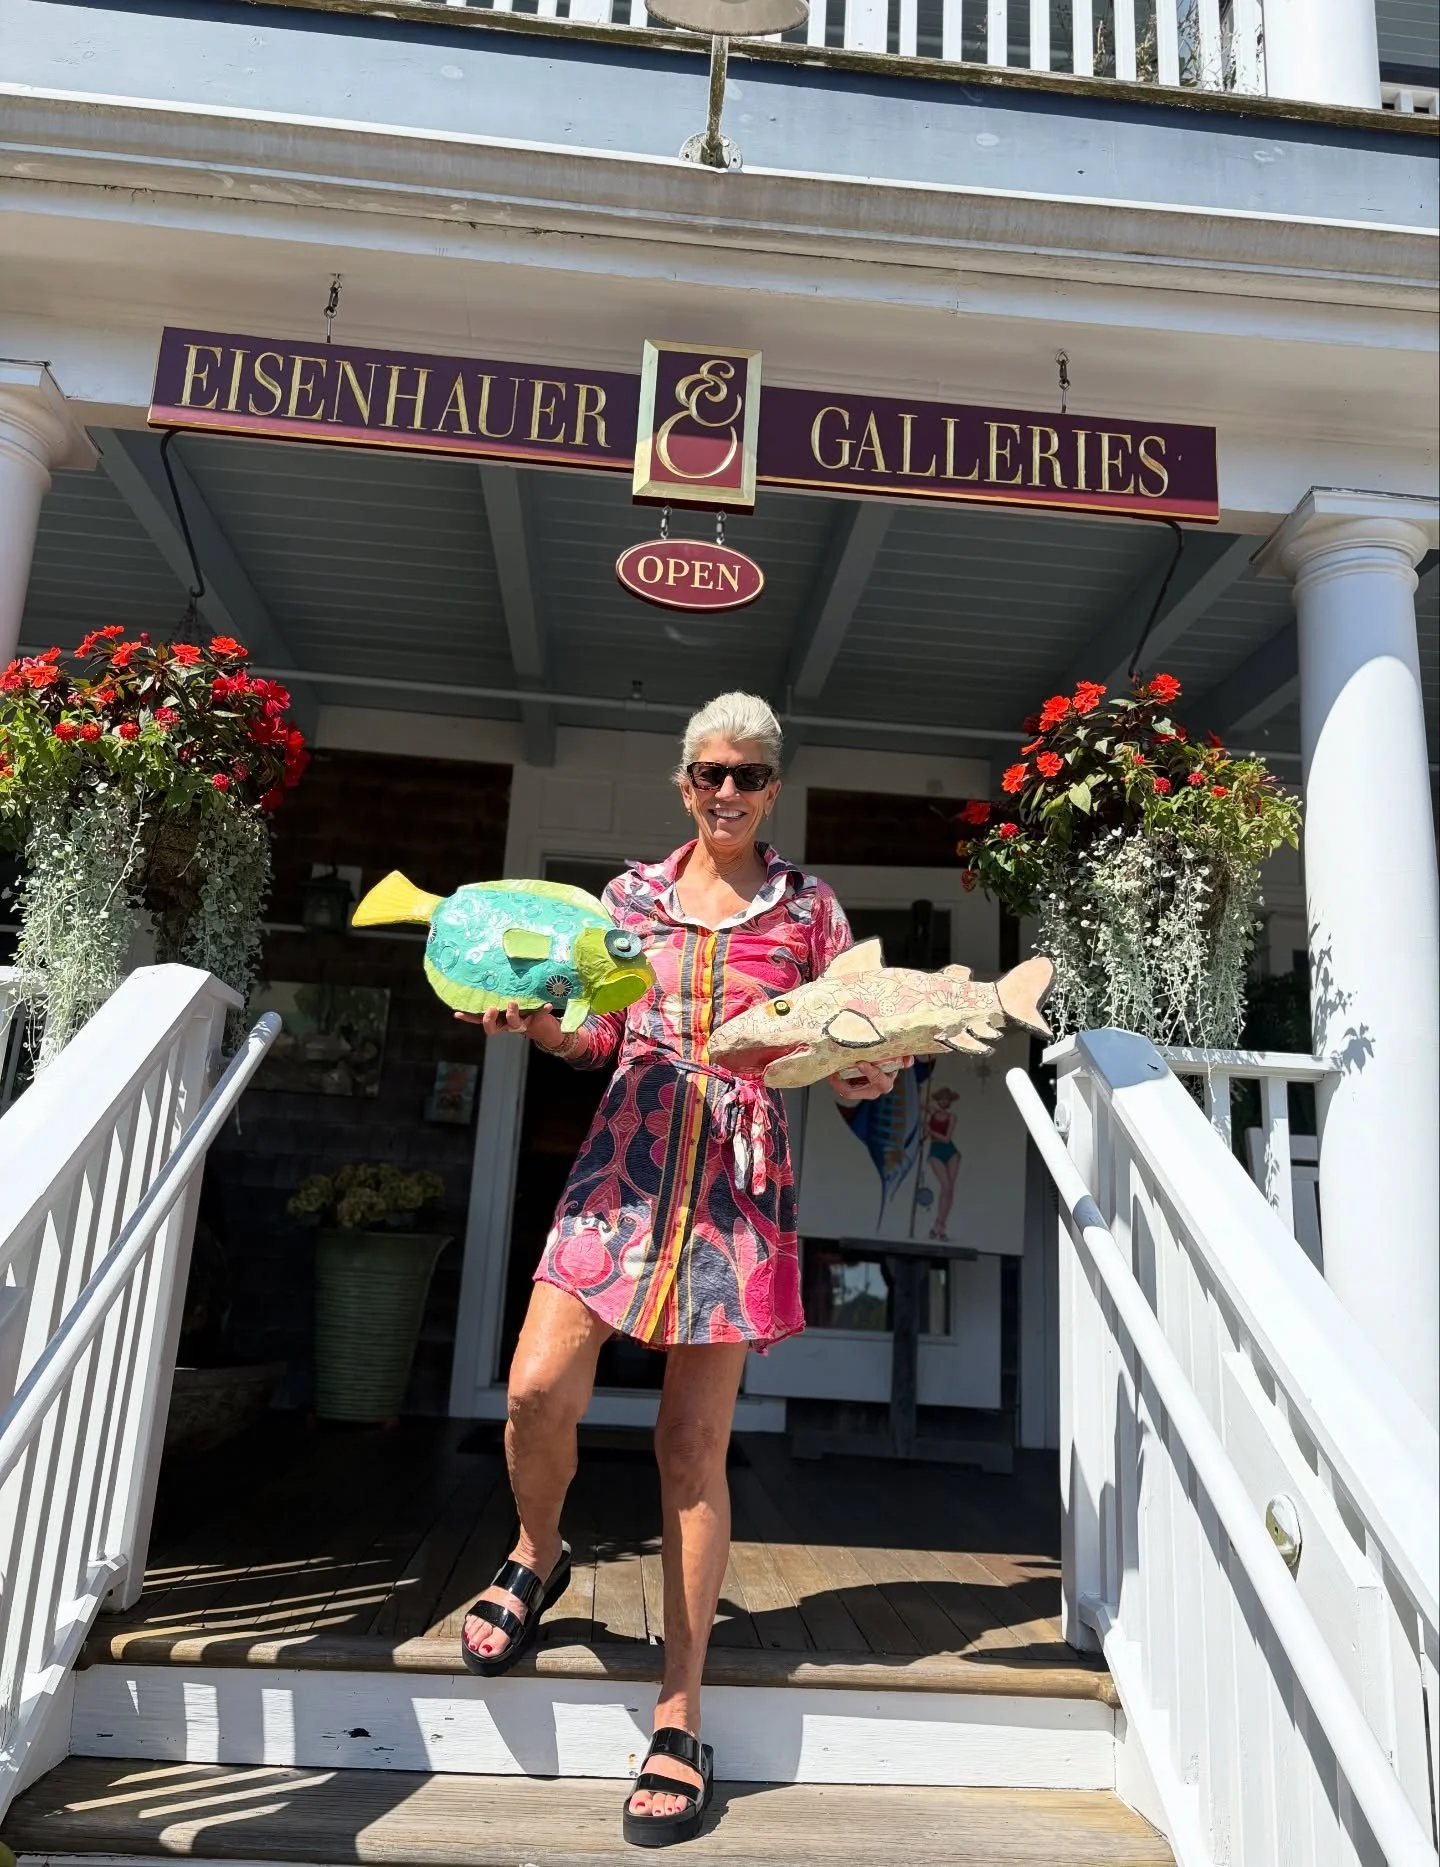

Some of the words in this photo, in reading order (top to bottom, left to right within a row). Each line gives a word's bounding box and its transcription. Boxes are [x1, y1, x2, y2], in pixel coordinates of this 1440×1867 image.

[175, 344, 611, 448] EISENHAUER
[810, 406, 1169, 498] GALLERIES
[637, 555, 742, 593] OPEN
